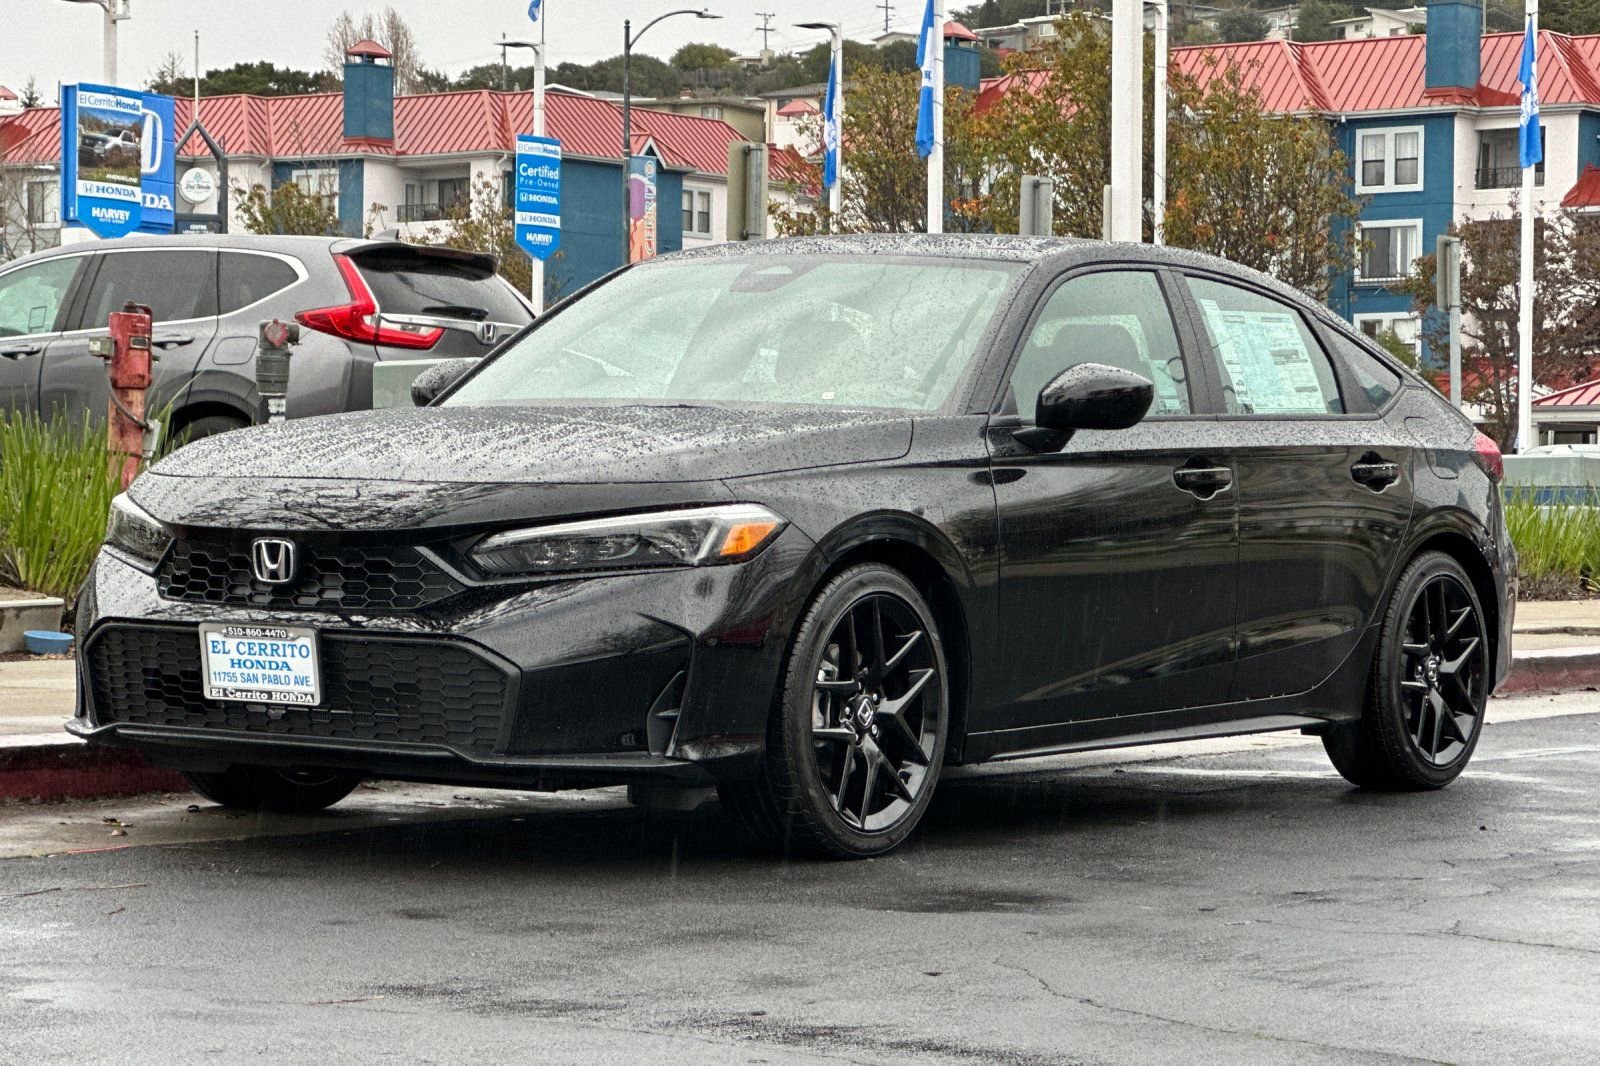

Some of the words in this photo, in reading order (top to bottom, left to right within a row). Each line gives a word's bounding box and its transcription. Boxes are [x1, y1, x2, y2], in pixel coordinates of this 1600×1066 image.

[79, 94, 87, 105] El
[519, 163, 559, 180] Certified
[519, 177, 559, 189] Pre-Owned
[96, 185, 136, 198] HONDA
[529, 193, 558, 205] HONDA
[92, 206, 130, 221] HARVEY
[529, 215, 557, 225] HONDA
[526, 232, 553, 243] HARVEY
[227, 627, 287, 638] 510-860-4470
[210, 640, 230, 654] EL
[236, 642, 310, 658] CERRITO
[229, 658, 292, 671] HONDA
[213, 671, 238, 683] 11755
[240, 673, 259, 684] SAN
[262, 674, 290, 686] PABLO
[211, 688, 223, 697] El
[272, 692, 313, 703] HONDA
